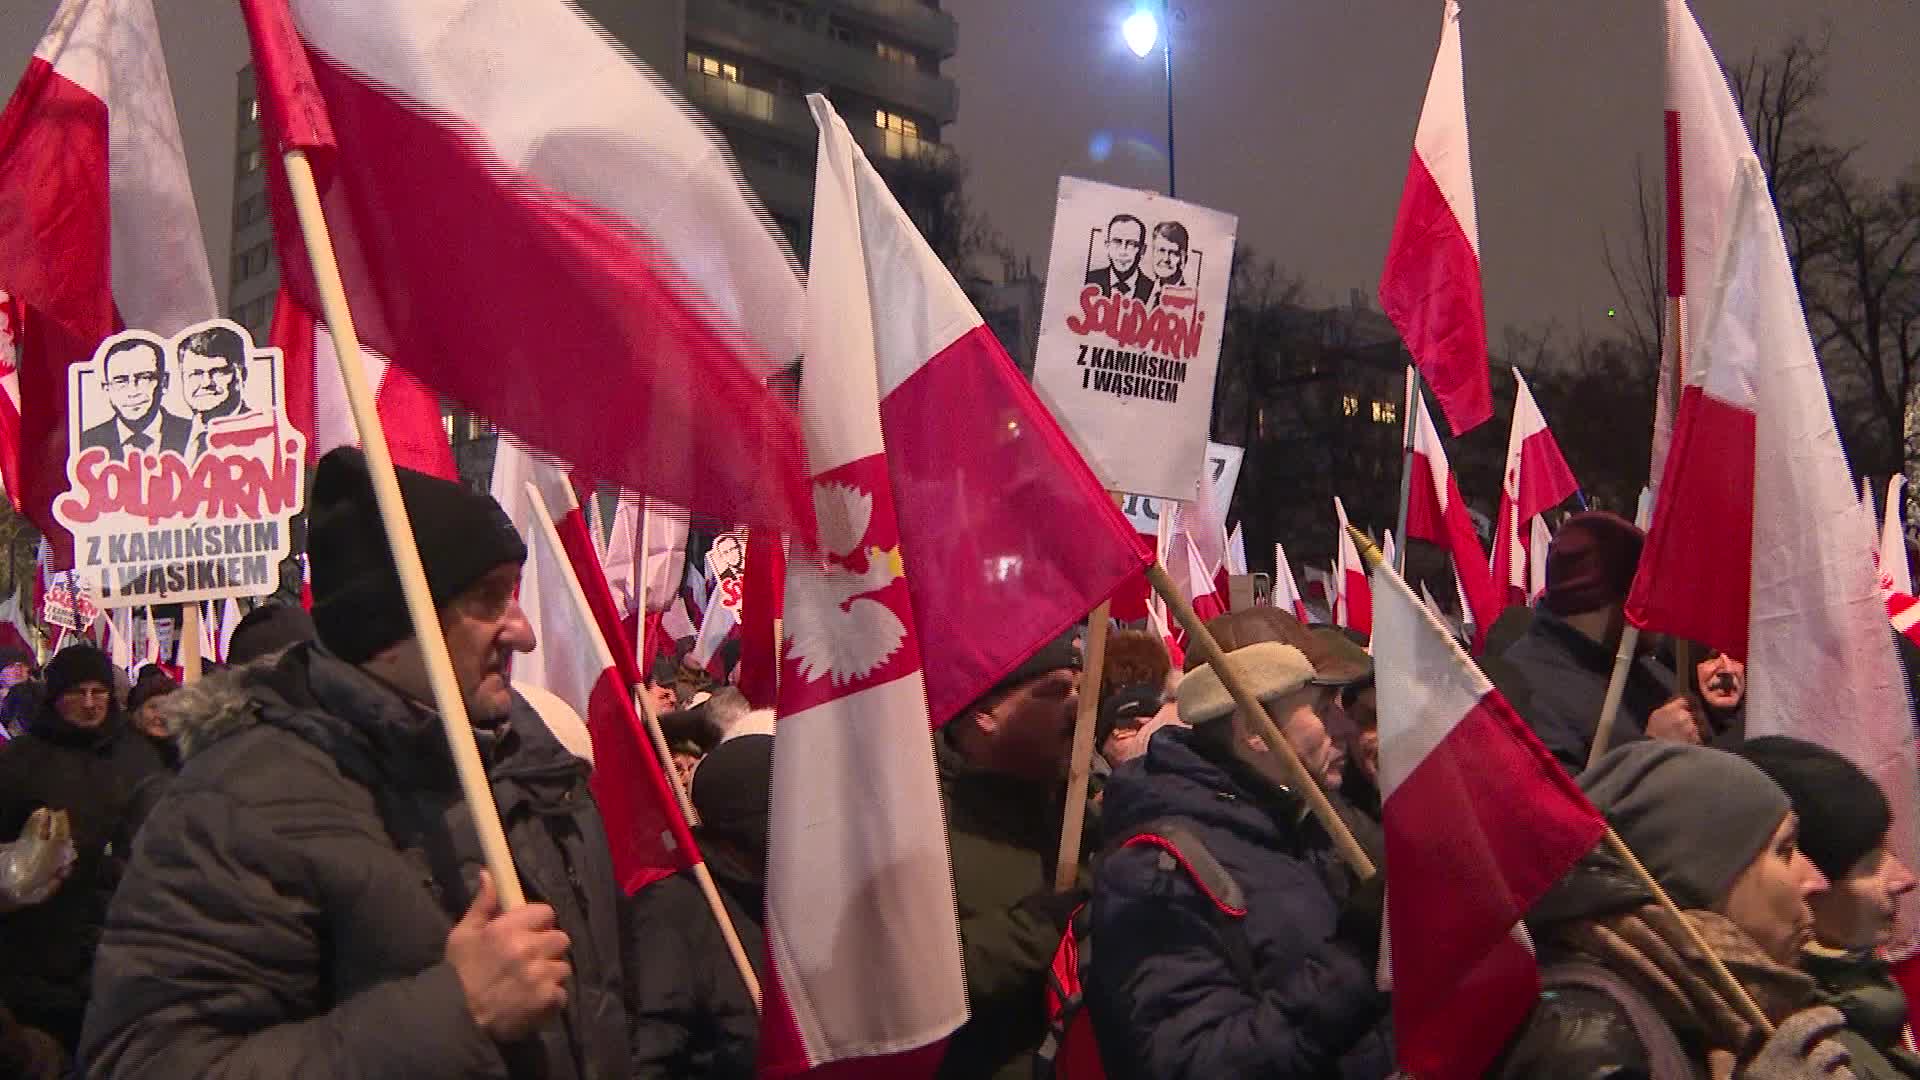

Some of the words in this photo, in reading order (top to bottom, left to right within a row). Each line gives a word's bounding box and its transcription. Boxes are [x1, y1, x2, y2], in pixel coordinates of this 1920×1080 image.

[1077, 344, 1088, 366] Z
[1090, 346, 1187, 383] KAMIŃSKIM
[1083, 368, 1090, 389] I
[1094, 370, 1178, 403] WĄSIKIEM
[87, 536, 102, 565] Z
[109, 521, 279, 564] KAMIŃSKIM
[101, 568, 110, 598] I
[118, 555, 268, 599] WĄSIKIEM
